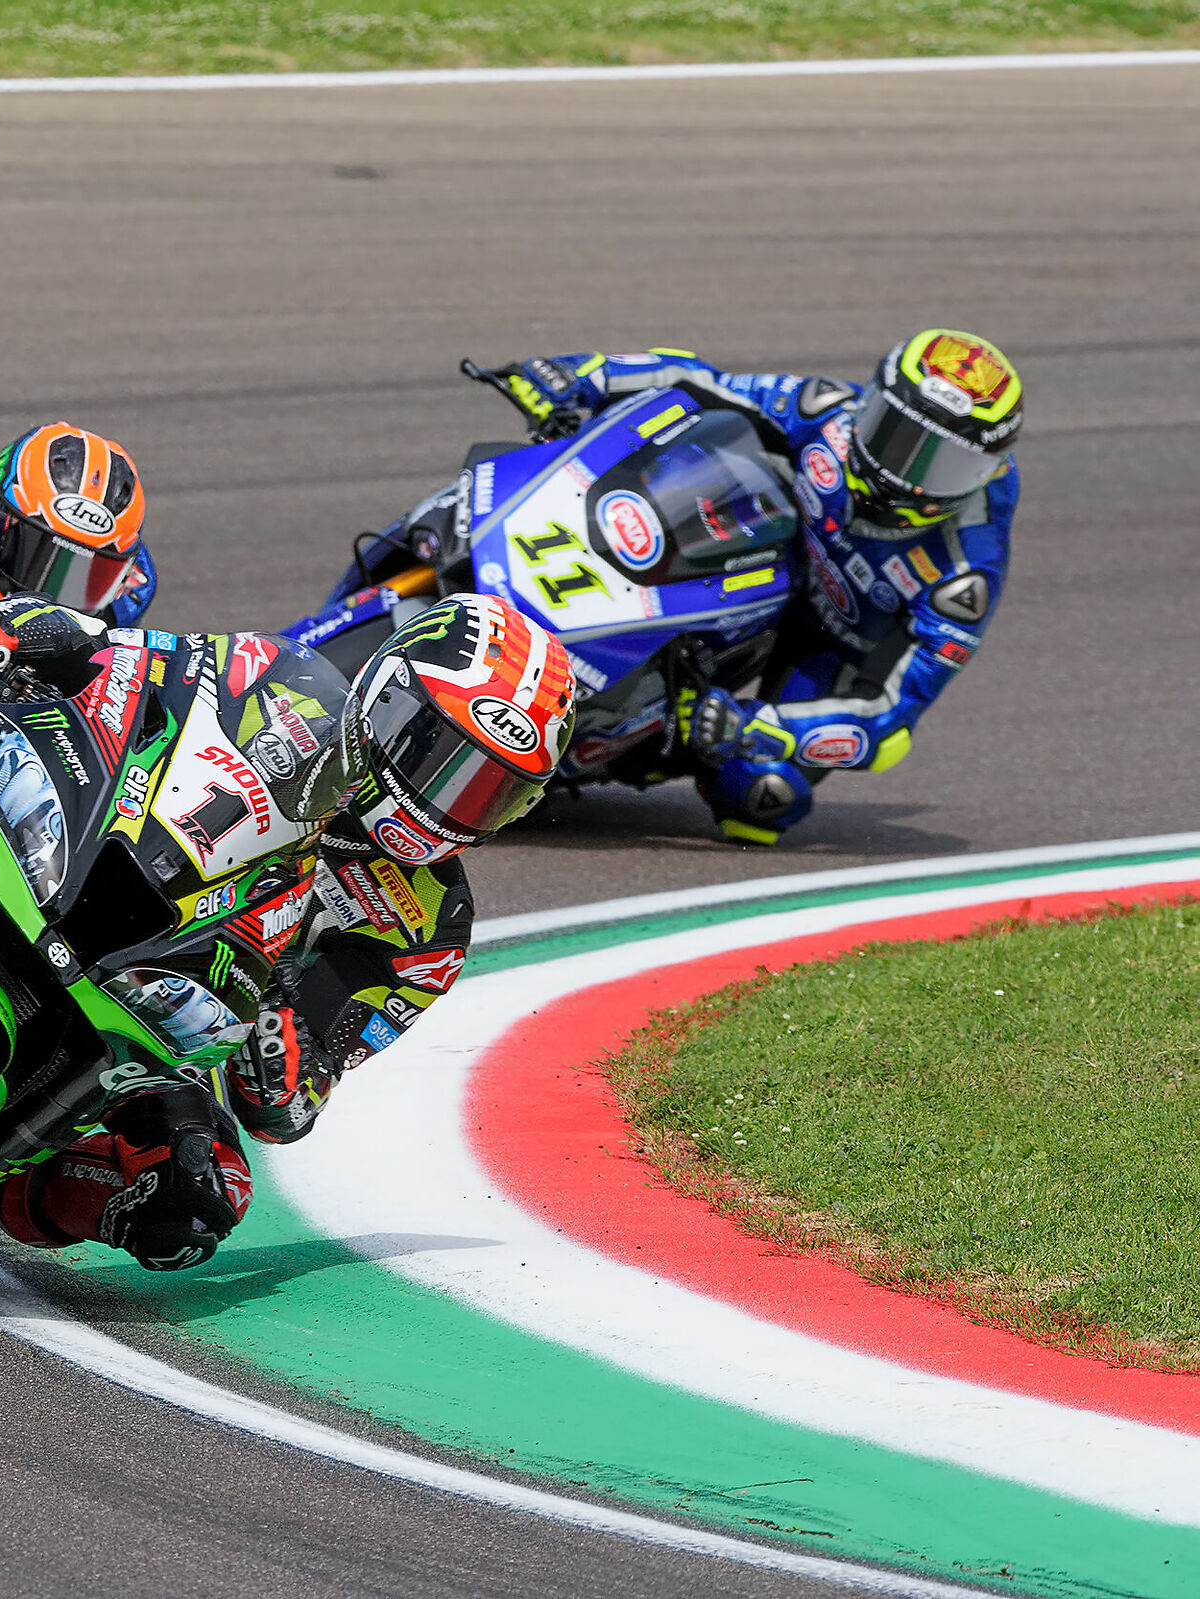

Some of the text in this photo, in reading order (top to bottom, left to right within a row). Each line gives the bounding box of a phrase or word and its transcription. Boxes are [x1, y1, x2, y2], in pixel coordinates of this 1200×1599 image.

[56, 501, 106, 528] Arai
[509, 520, 615, 609] 11
[274, 696, 319, 754] SHOWA
[475, 707, 536, 745] Arai
[258, 736, 292, 772] Arai
[122, 764, 150, 803] elf
[194, 746, 271, 835] SHOWA
[381, 767, 478, 844] www.jonathan-rea.com
[383, 828, 420, 857] PATA
[195, 890, 221, 920] elf
[325, 886, 357, 924] J.JUAN
[377, 862, 424, 923] PIRELLI
